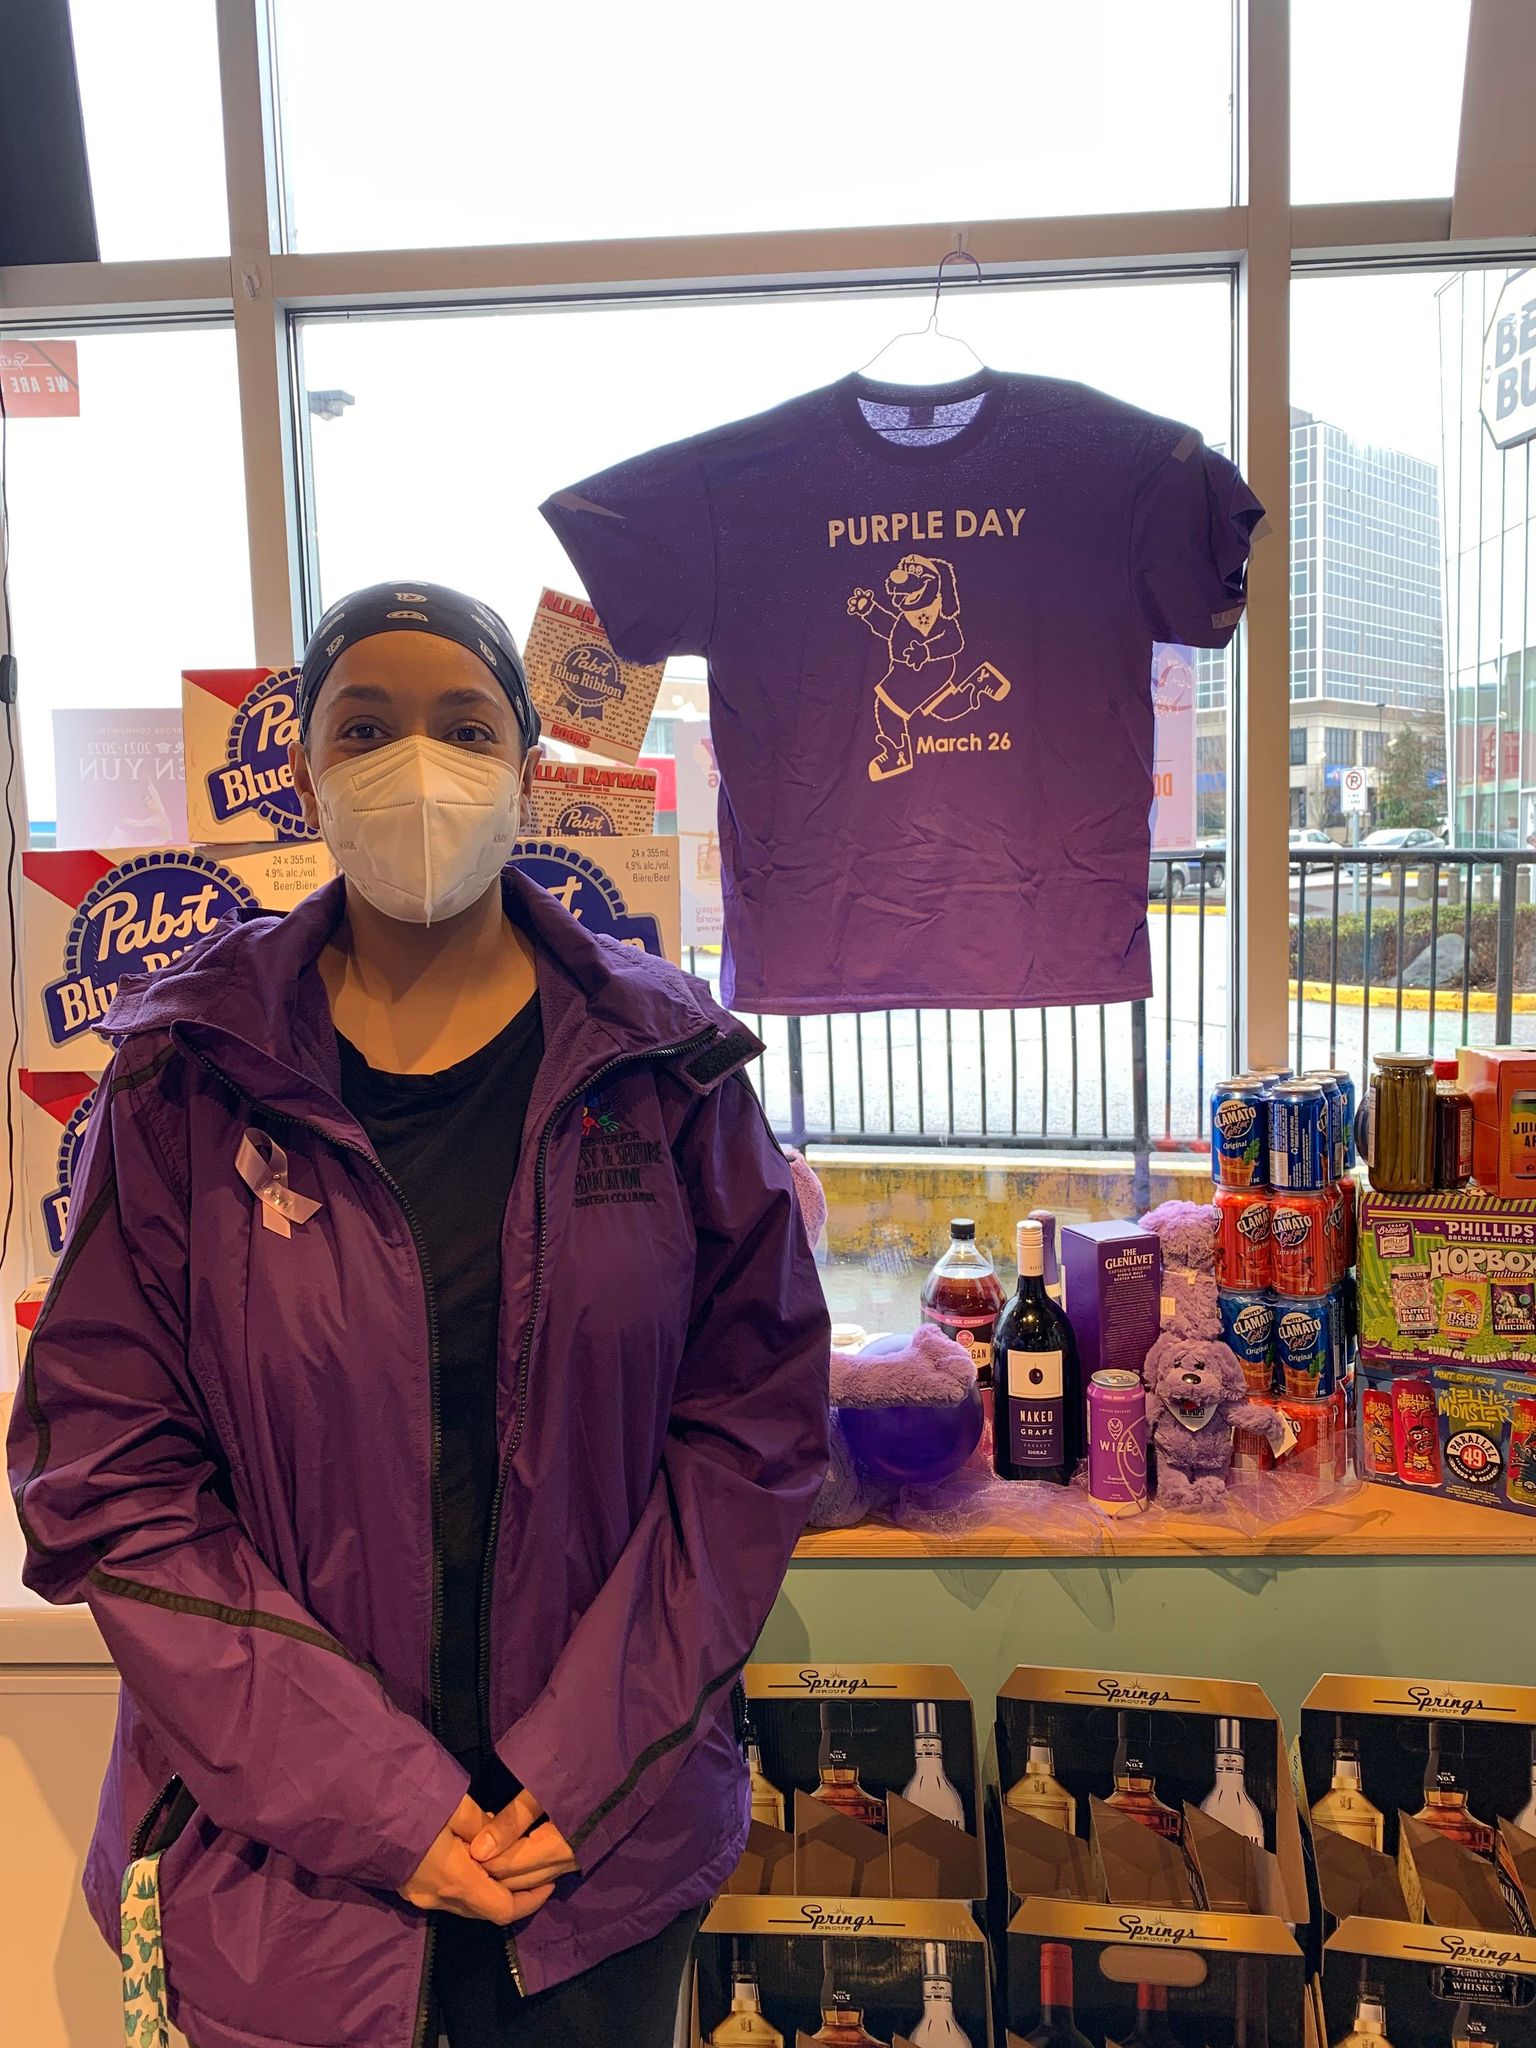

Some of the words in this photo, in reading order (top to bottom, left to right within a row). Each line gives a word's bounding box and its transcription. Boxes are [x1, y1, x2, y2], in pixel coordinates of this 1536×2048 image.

[827, 510, 945, 547] PURPLE
[955, 507, 1027, 538] DAY
[540, 591, 597, 624] ALLAN
[570, 649, 613, 677] Pabst
[552, 663, 580, 684] Blue
[579, 671, 622, 700] Ribbon
[550, 723, 592, 749] BOOKS
[916, 732, 982, 754] March
[987, 731, 1011, 751] 26
[582, 766, 657, 792] RAYMAN
[565, 808, 605, 830] Pabst
[272, 855, 282, 865] 24
[283, 857, 289, 865] x
[290, 854, 304, 865] 355
[631, 848, 640, 857] 24
[87, 883, 220, 962] Pabst
[1222, 1139, 1248, 1150] Original
[1445, 1221, 1535, 1238] PHILLIPS
[1105, 1253, 1154, 1270] GLENLIVET
[1122, 1247, 1137, 1257] THE
[1401, 1314, 1431, 1322] BOMB
[1446, 1318, 1479, 1330] SHARK
[1448, 1311, 1478, 1321] TIGER
[1278, 1318, 1322, 1340] CLAMATO
[1287, 1353, 1313, 1362] Original
[1427, 1346, 1452, 1357] TURN
[1452, 1350, 1466, 1361] ON
[1470, 1353, 1496, 1364] TUNE
[1496, 1351, 1508, 1361] IN
[1512, 1352, 1531, 1362] HOP
[1450, 1387, 1500, 1405] JELLY
[1020, 1410, 1053, 1422] NAKED
[1438, 1396, 1514, 1425] MONSTER
[1020, 1428, 1054, 1436] GRAPE
[1099, 1440, 1133, 1453] WIZE
[1450, 1433, 1497, 1459] PARALLEL
[1463, 1447, 1482, 1467] 49
[799, 1669, 869, 1695] Springs
[1097, 1678, 1170, 1706] Springs
[1407, 1686, 1484, 1715] Springs
[801, 1904, 875, 1932] Springs
[1118, 1914, 1195, 1944] Springs
[1440, 1935, 1521, 1966] Springs
[1457, 1956, 1495, 1965] GROUP
[1452, 1981, 1505, 1993] WHISKEY
